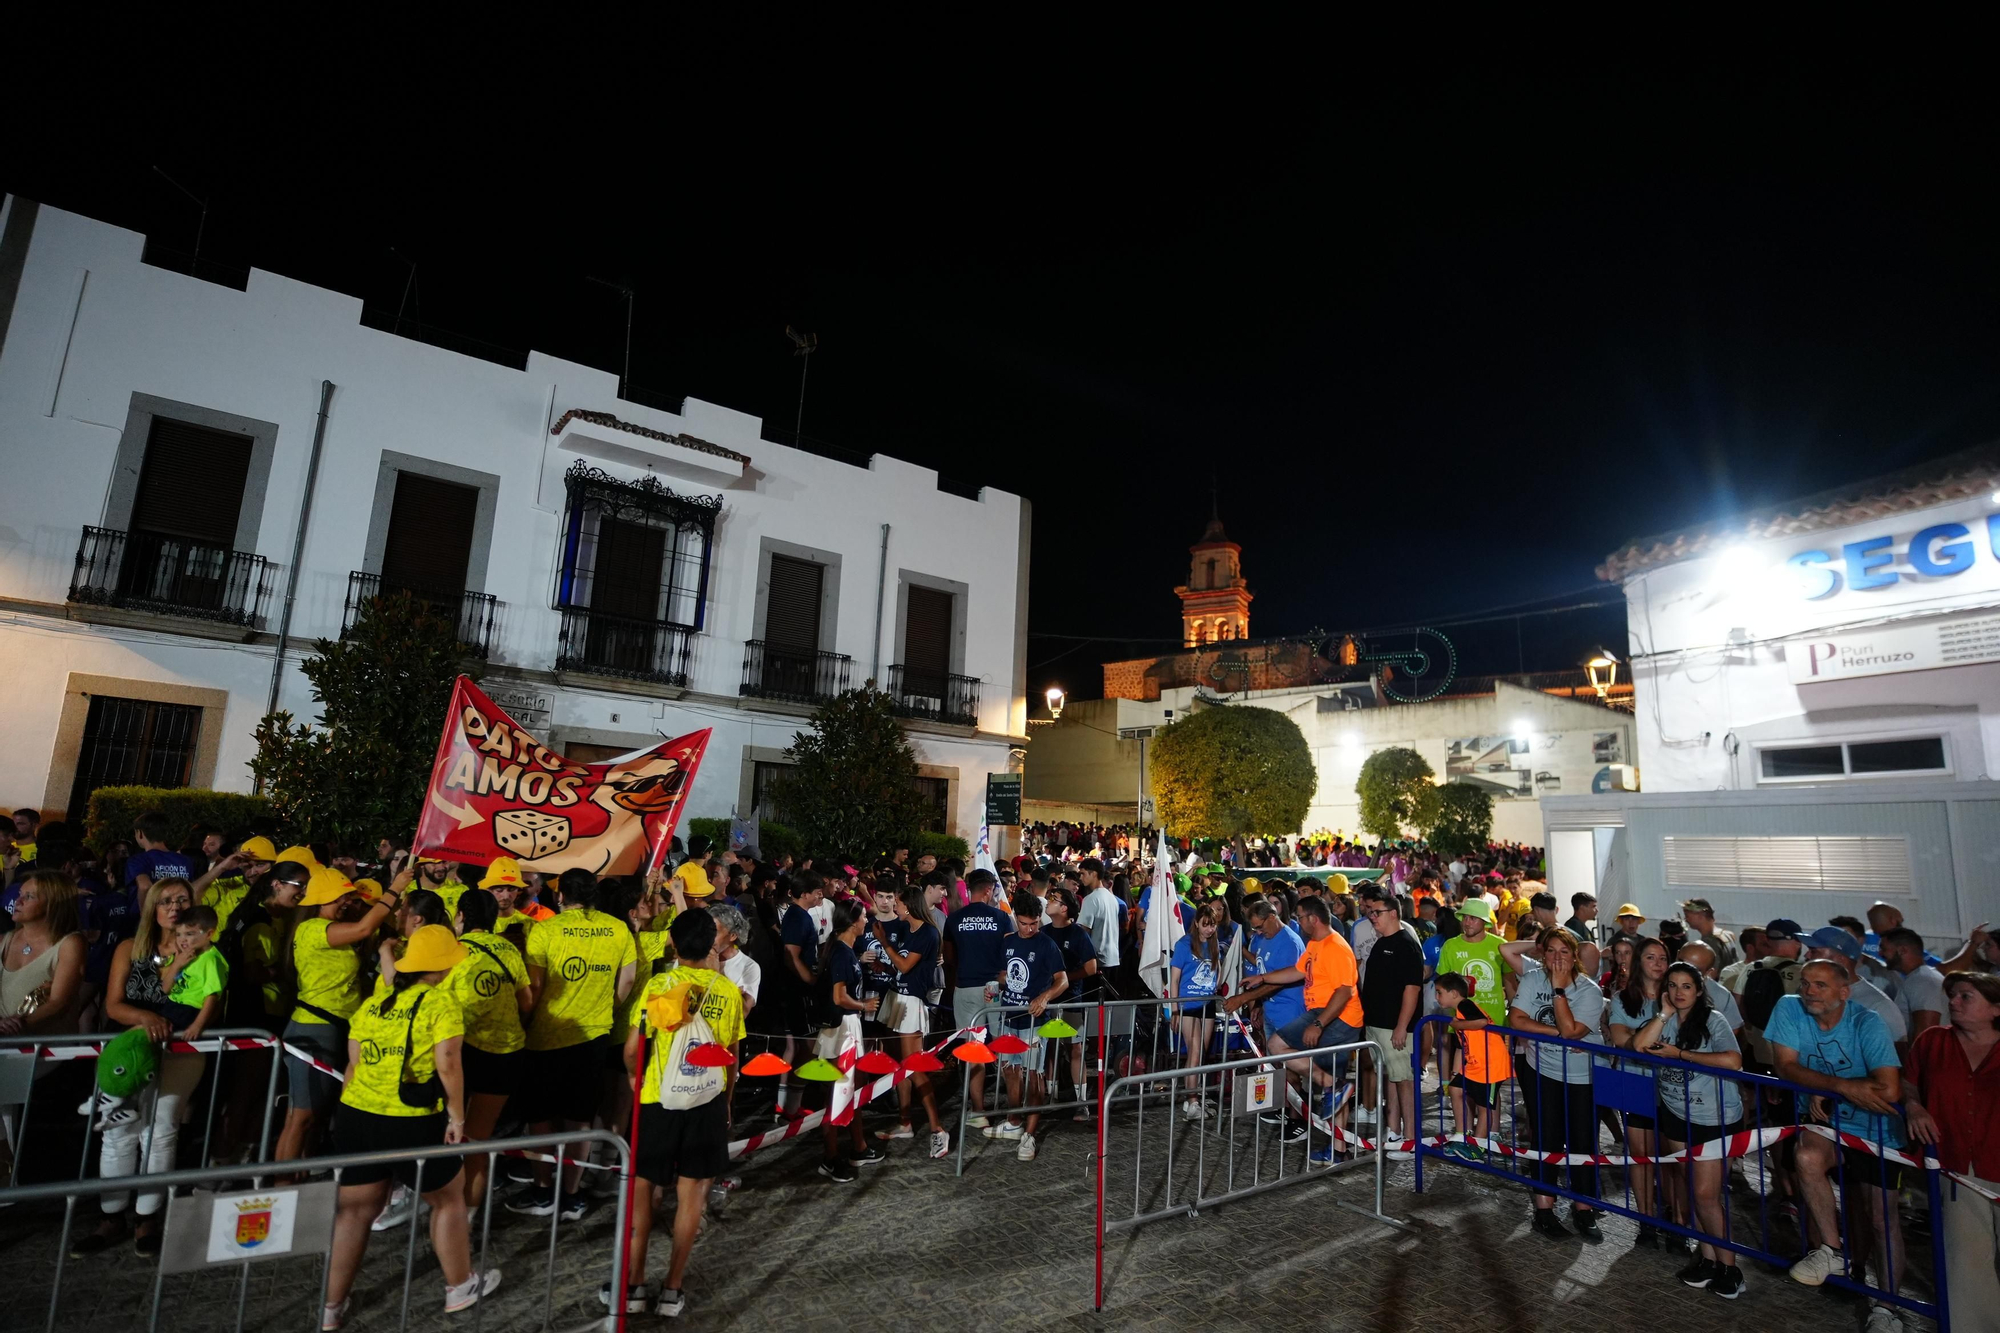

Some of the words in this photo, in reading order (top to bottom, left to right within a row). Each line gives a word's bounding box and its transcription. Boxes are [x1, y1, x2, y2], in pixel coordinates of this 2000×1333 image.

[1787, 514, 2000, 601] SEG
[1840, 643, 1874, 656] Puri
[1842, 650, 1914, 668] Herruzo
[612, 714, 618, 723] 6
[446, 751, 584, 807] AMOS
[563, 927, 615, 938] PATOSAMOS
[958, 922, 998, 932] FIESTOKAS
[1456, 951, 1468, 959] XII
[588, 964, 612, 972] FIBRA
[382, 1046, 405, 1057] FIBR
